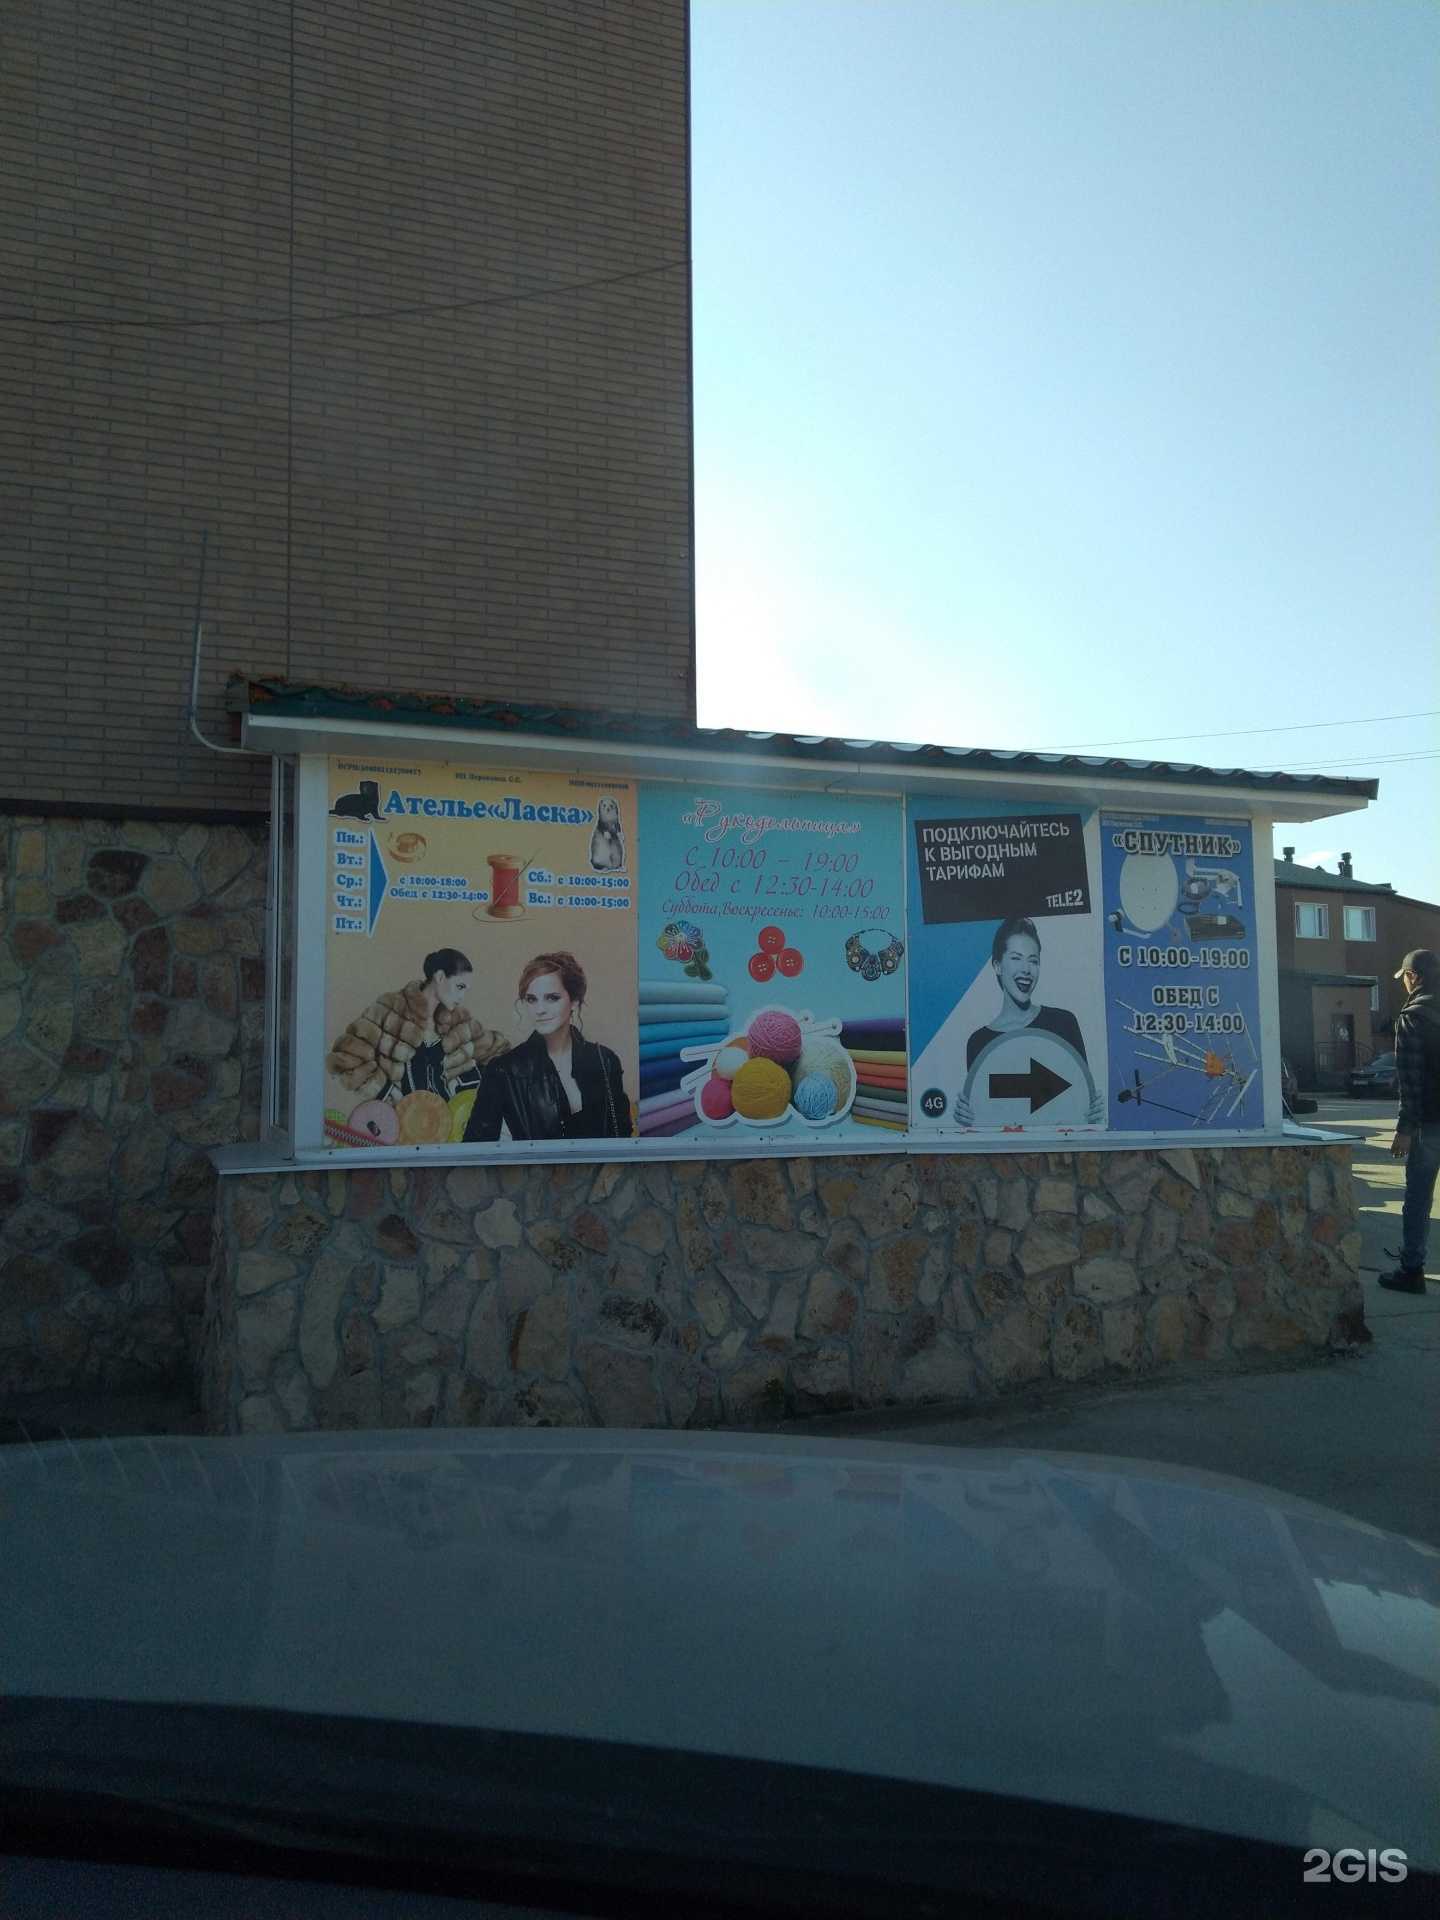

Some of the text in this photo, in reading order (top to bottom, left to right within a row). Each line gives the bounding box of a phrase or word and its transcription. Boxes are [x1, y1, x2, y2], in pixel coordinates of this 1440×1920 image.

[336, 832, 364, 844] Пн.:
[922, 821, 1070, 844] ПОДКЛЮЧАЙТЕСЬ
[925, 842, 1038, 862] К ВЫГОДНЫМ
[1112, 830, 1241, 858] «СПУТНИК»
[336, 853, 362, 866] Вт.:
[711, 848, 767, 870] 10:00
[804, 851, 860, 873] 19:00
[336, 874, 362, 888] Ср.:
[528, 872, 551, 883] Сб.:
[568, 876, 630, 888] 10:00-15:00
[926, 863, 1005, 881] ТАРИФАМ
[675, 870, 720, 894] Обед
[753, 874, 875, 898] 12:30-14:00
[336, 896, 362, 908] Чт.:
[390, 887, 418, 899] Обед
[431, 890, 488, 901] 12:30-14:00
[528, 893, 551, 904] Вс.:
[568, 897, 630, 909] 10:00-15:00
[1045, 889, 1084, 907] TELE2
[336, 917, 362, 929] Пт.:
[1137, 948, 1249, 967] 10:00-19:00
[1153, 986, 1204, 1007] ОБЕД
[1134, 1014, 1244, 1034] 12:30-14:00
[925, 1097, 943, 1110] 4G
